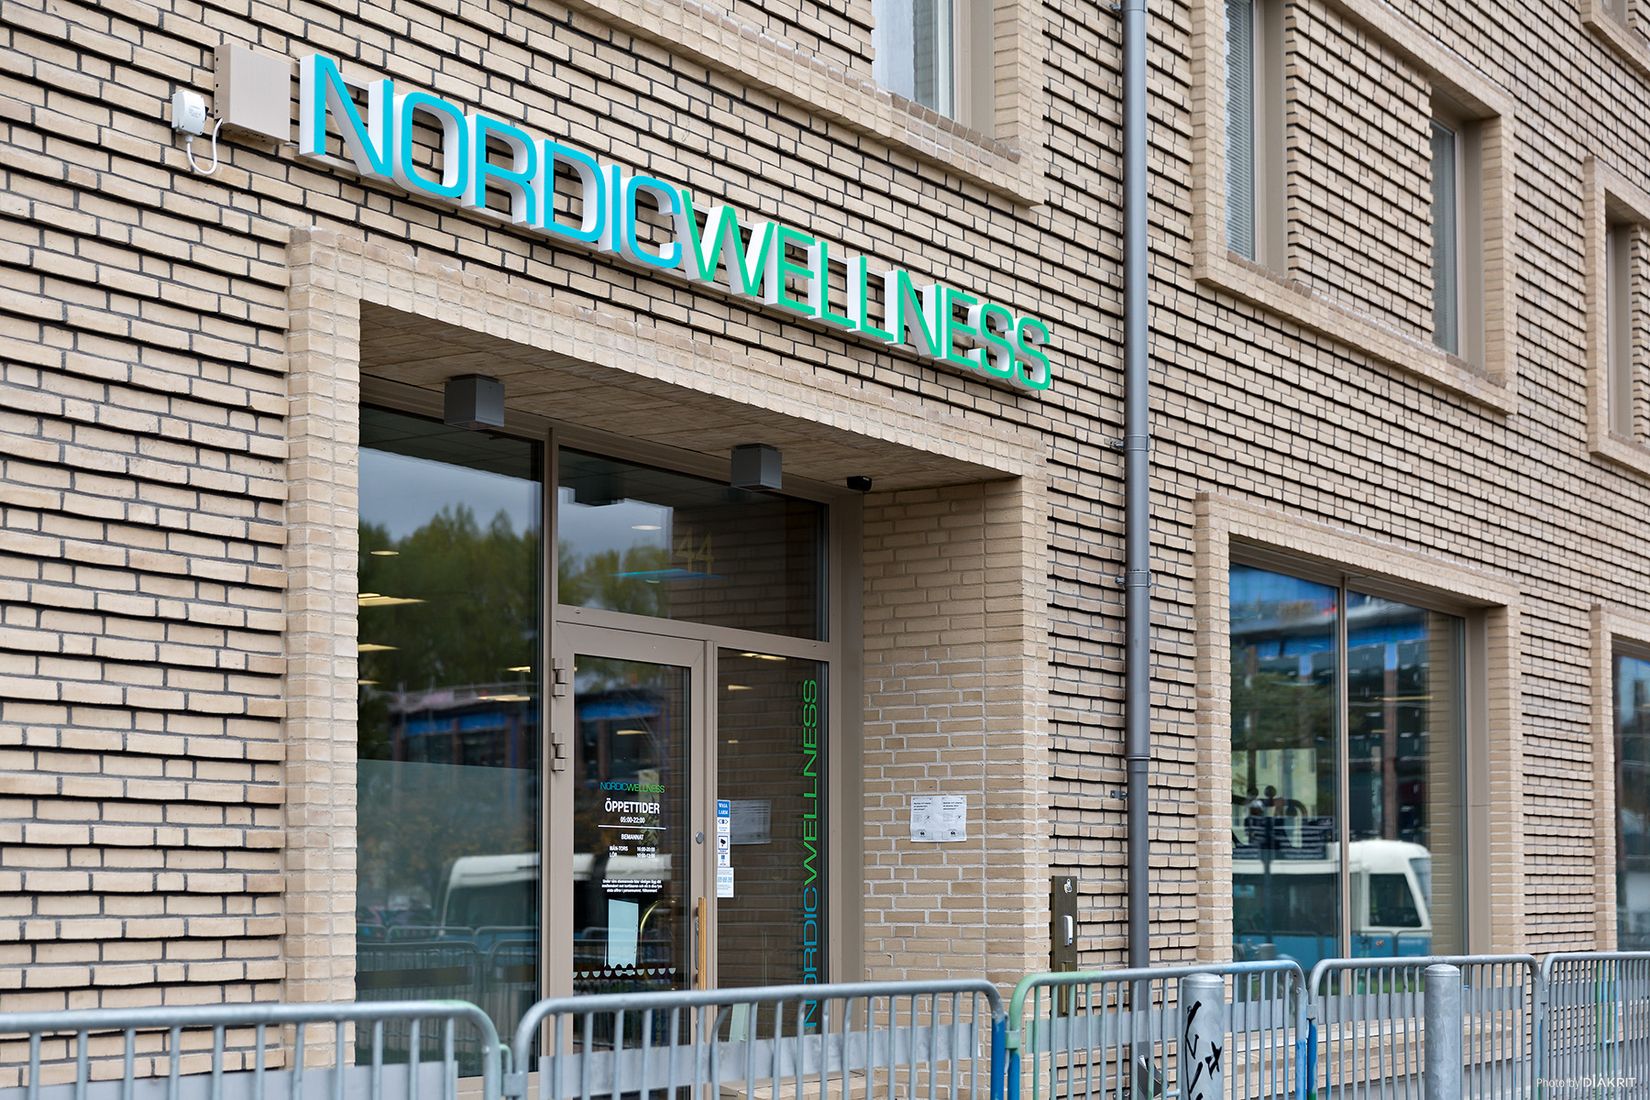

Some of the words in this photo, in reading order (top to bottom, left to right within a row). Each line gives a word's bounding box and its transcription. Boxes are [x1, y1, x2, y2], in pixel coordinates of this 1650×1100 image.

[299, 53, 1052, 392] NORDICWELLNESS
[675, 527, 715, 576] 44
[600, 782, 665, 793] NORDICWELLNESS
[604, 797, 660, 814] ÖPPETTIDER
